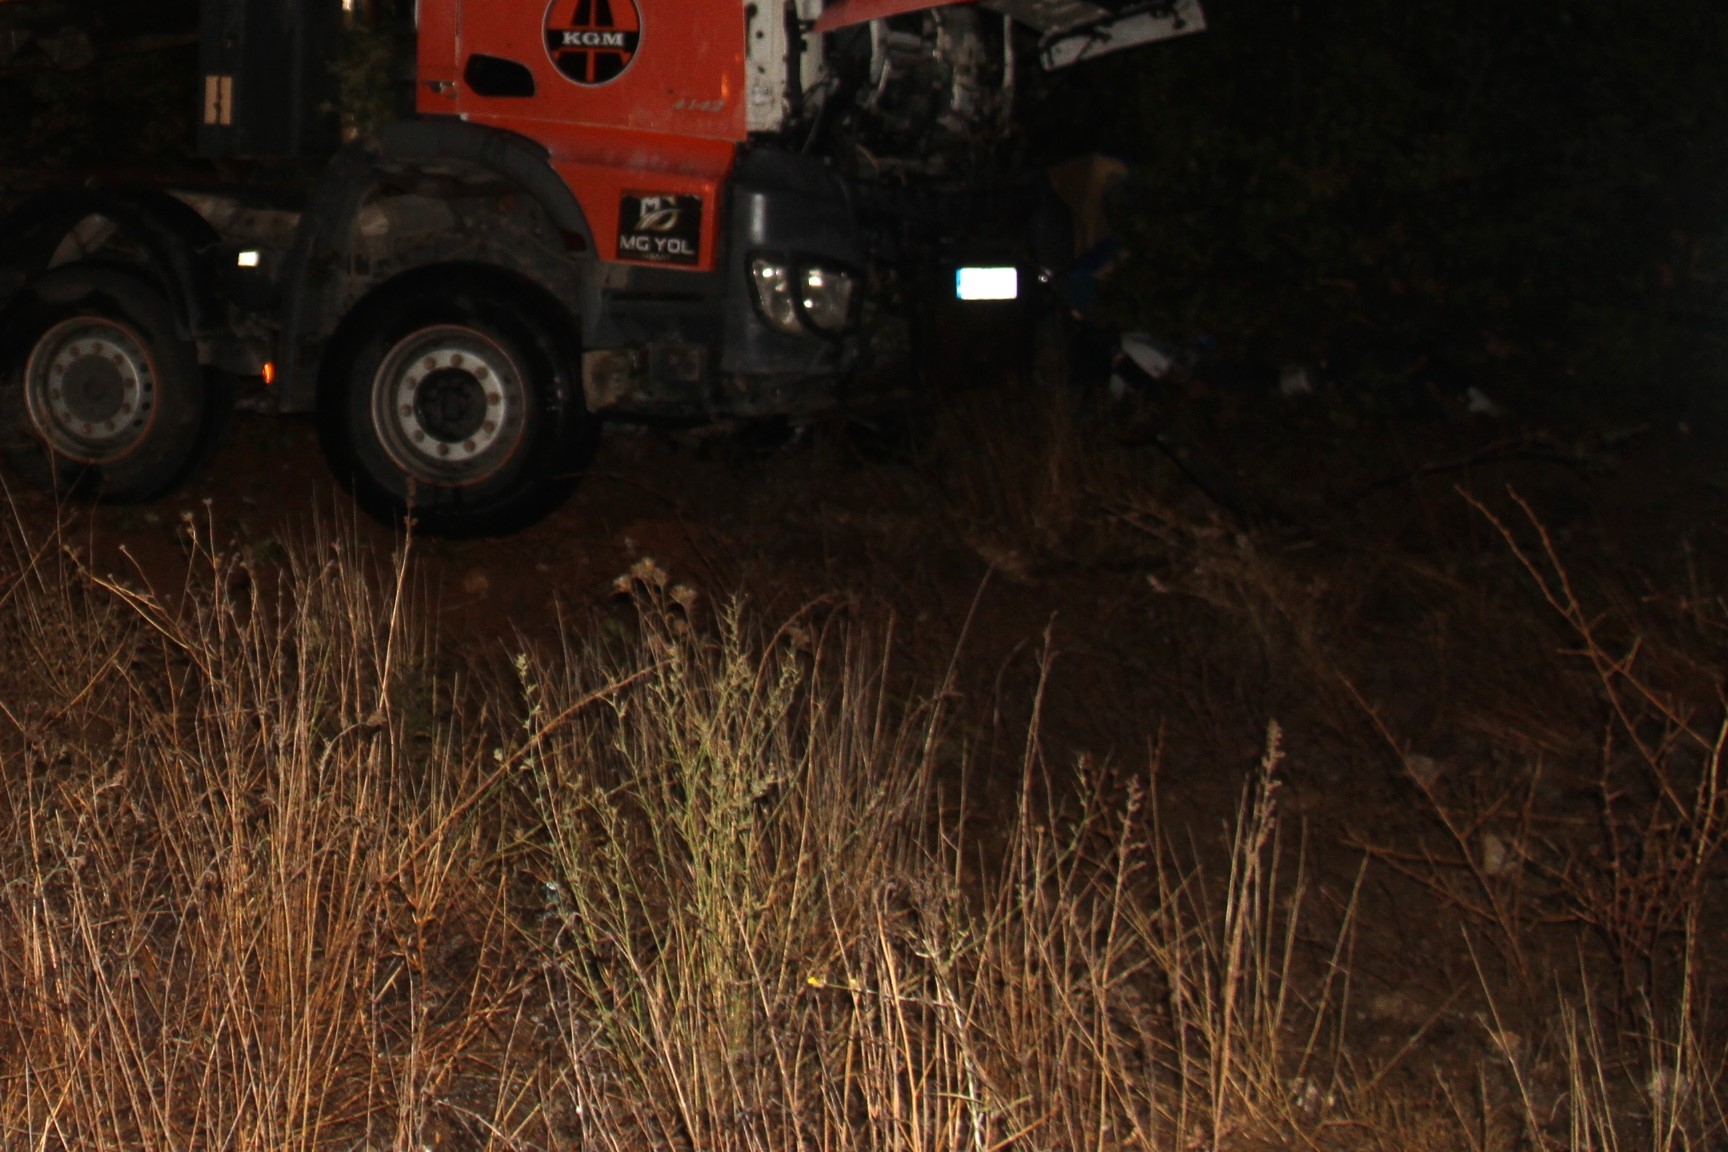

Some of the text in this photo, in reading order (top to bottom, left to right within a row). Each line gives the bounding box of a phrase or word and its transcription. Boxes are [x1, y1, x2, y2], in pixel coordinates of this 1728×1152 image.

[561, 31, 624, 47] KGM
[619, 234, 650, 252] MG
[653, 237, 696, 256] YOL
